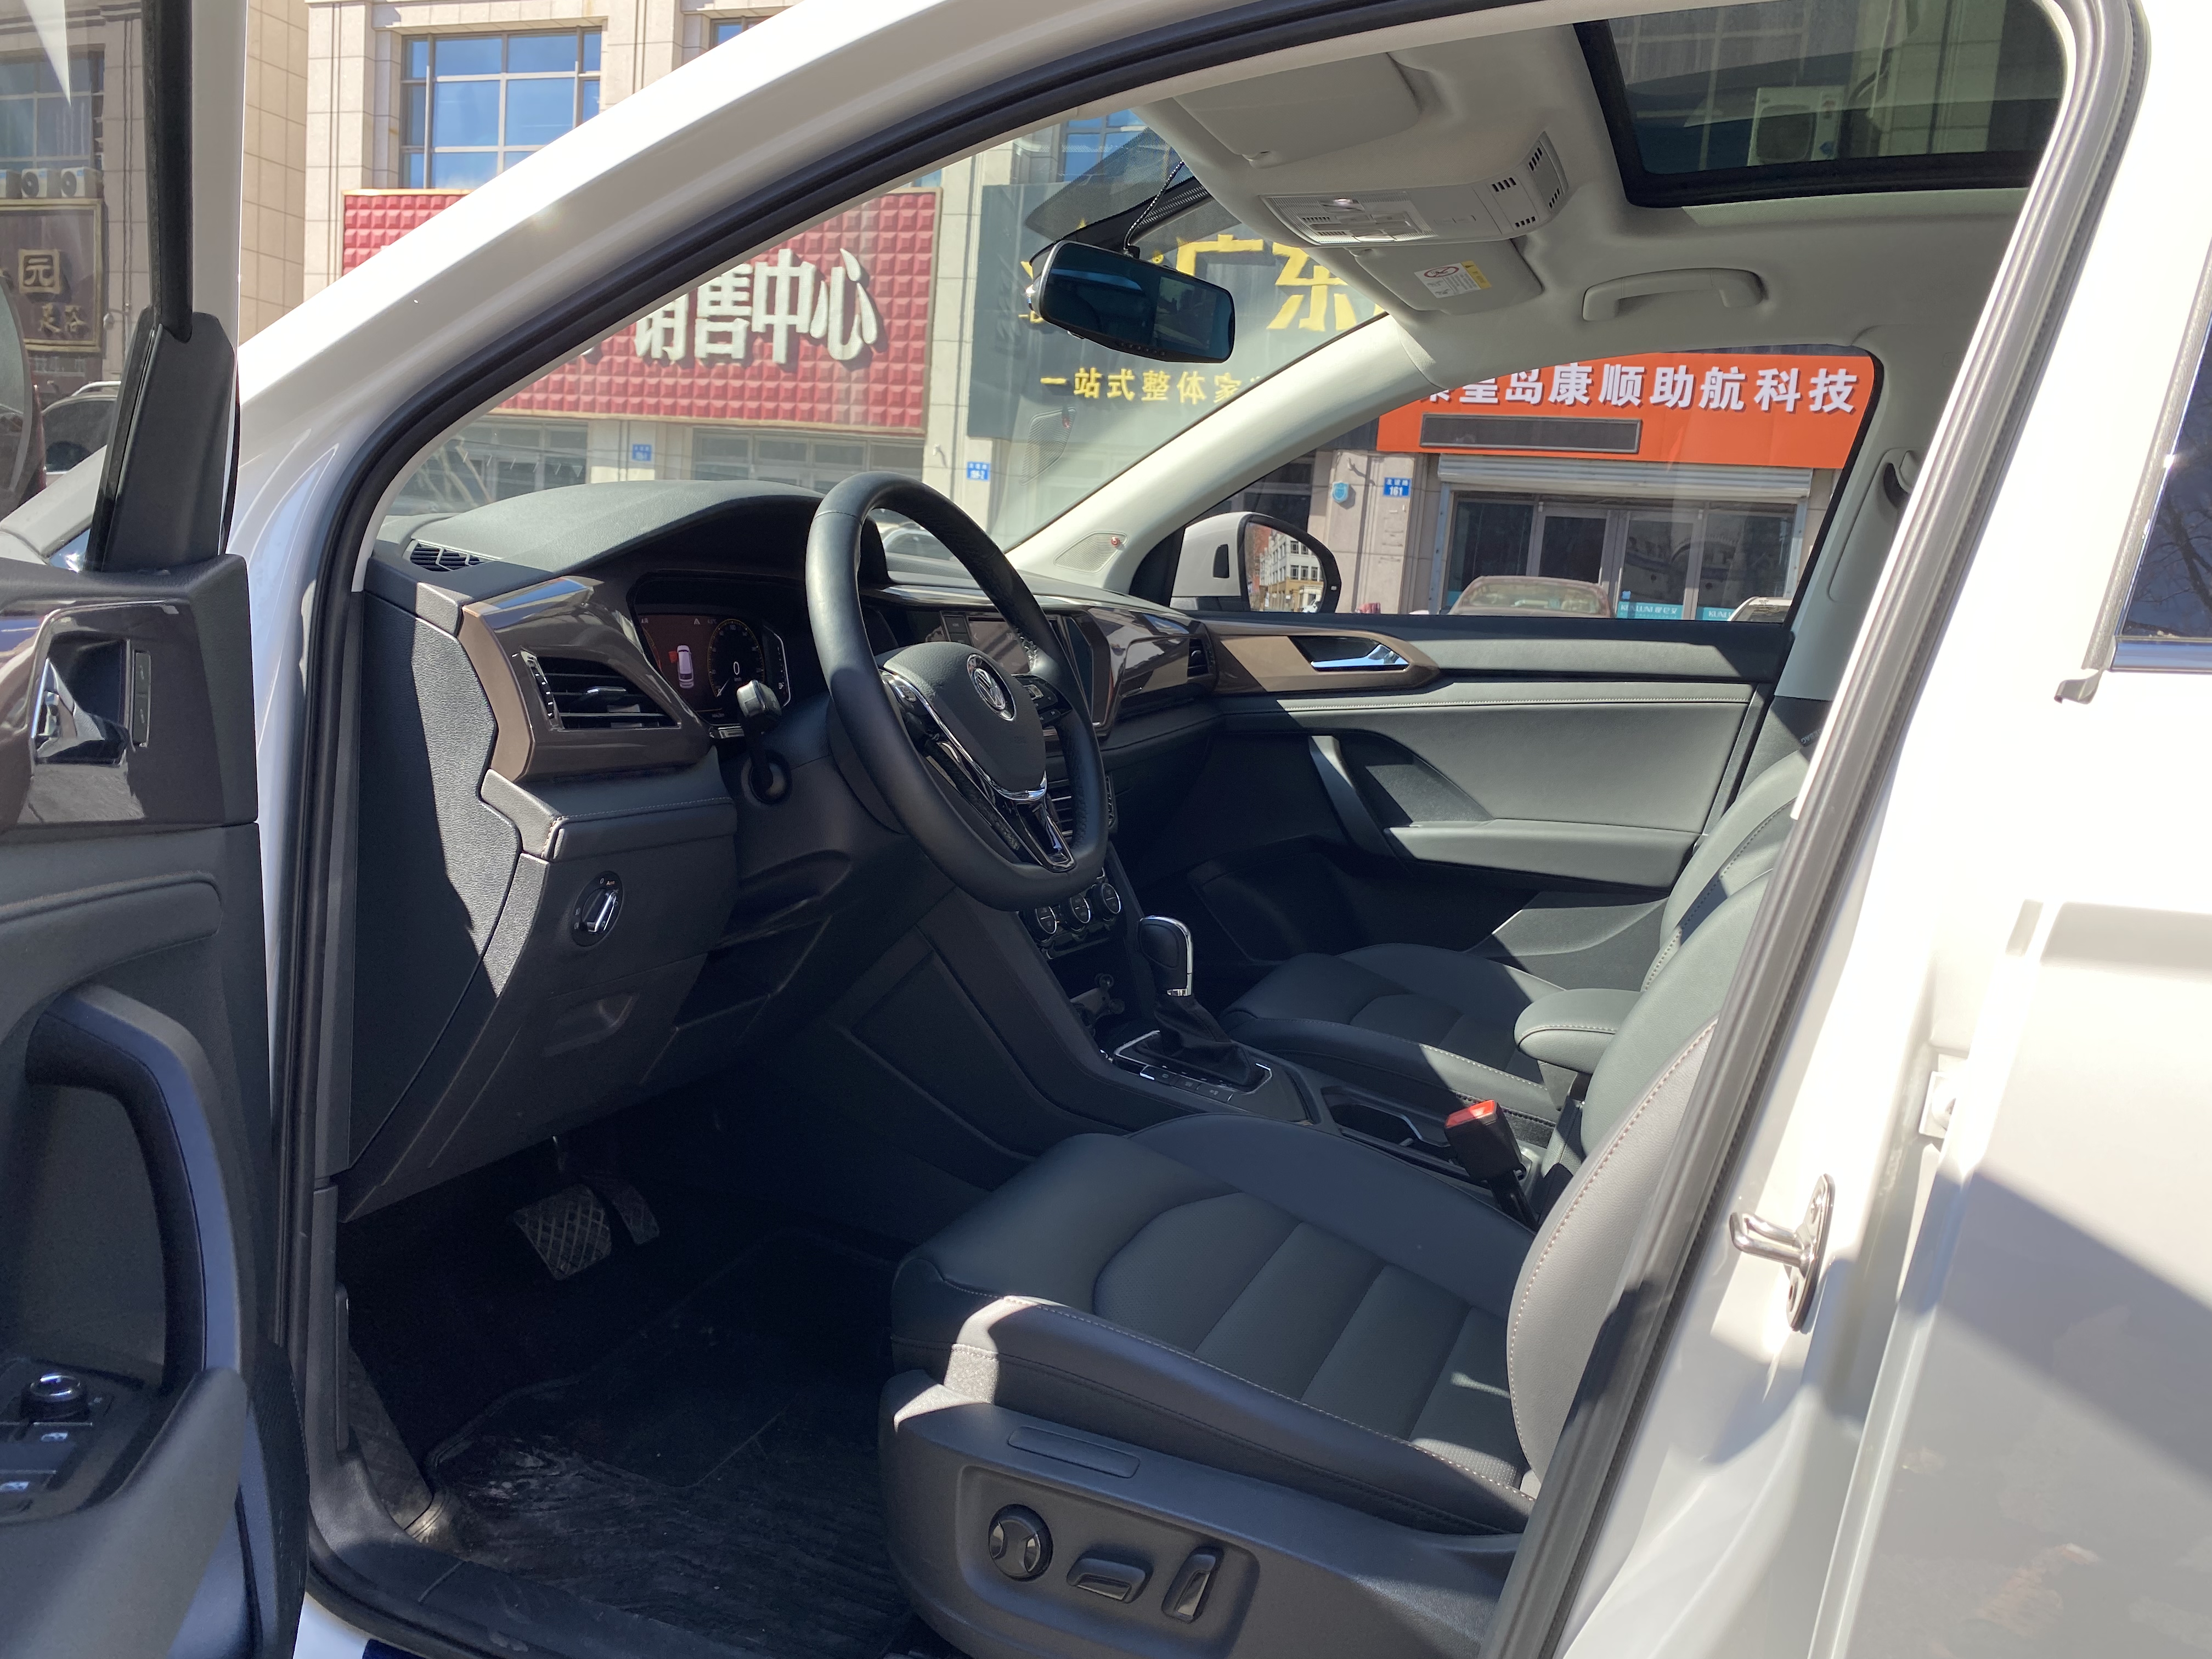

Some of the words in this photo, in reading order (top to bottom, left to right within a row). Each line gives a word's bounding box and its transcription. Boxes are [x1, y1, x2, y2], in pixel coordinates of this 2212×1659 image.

[1176, 234, 1384, 331] 广东
[1040, 367, 1260, 405] 一站式整体家
[1429, 363, 1858, 413] 皇岛康顺助航科技
